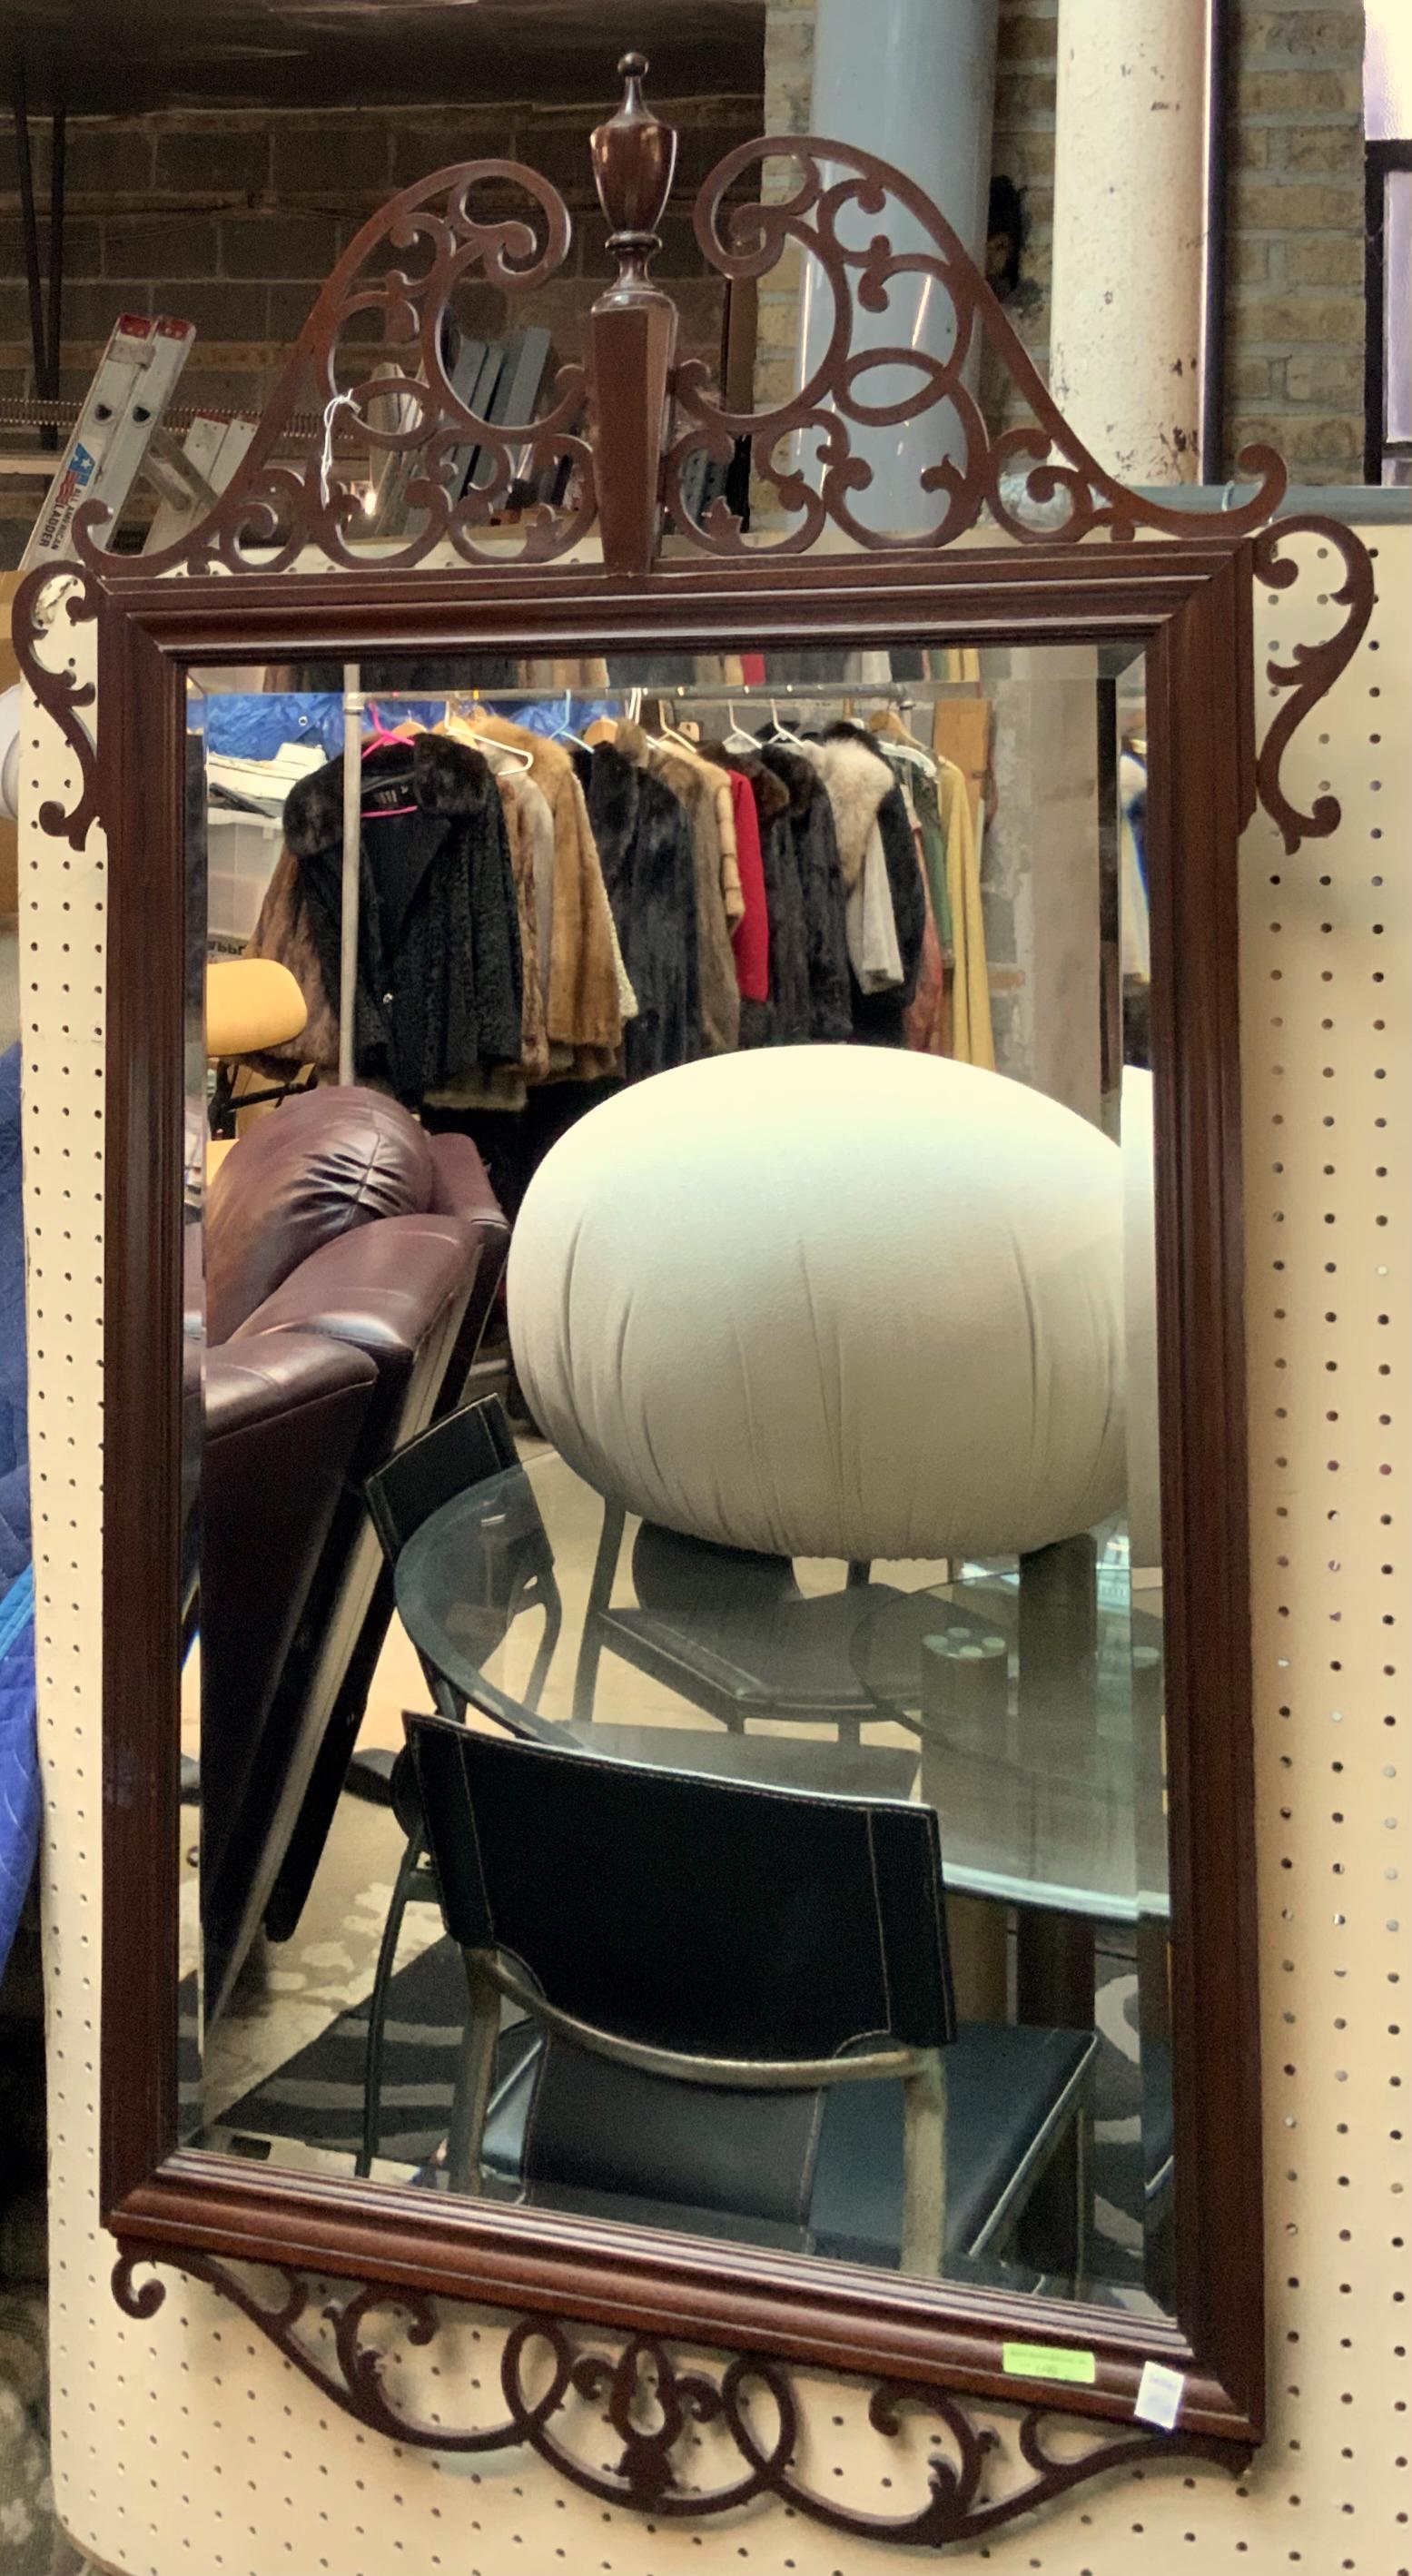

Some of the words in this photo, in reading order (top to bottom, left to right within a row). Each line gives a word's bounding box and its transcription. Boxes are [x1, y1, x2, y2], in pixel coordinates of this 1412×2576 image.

[70, 487, 82, 503] ALL
[38, 503, 64, 548] LADDER
[50, 505, 74, 550] AMERICAN
